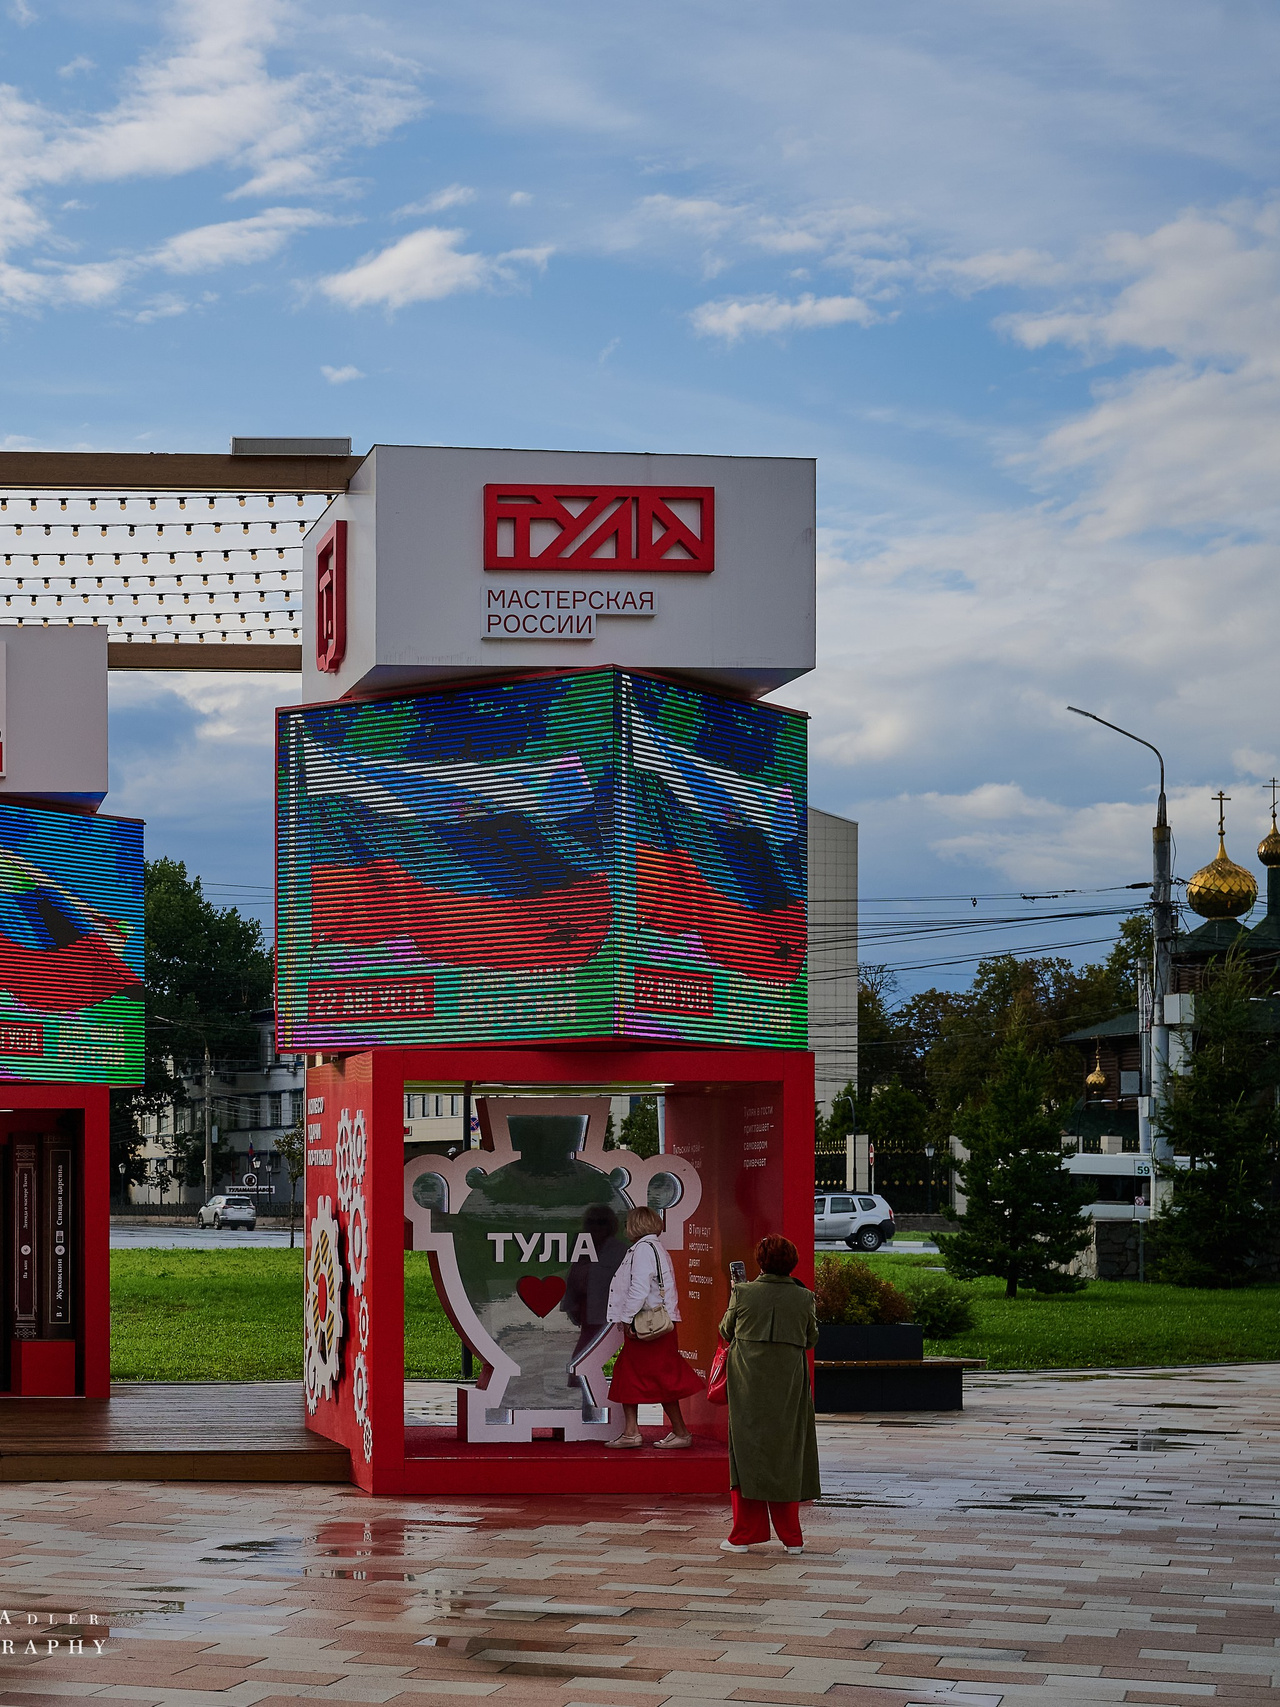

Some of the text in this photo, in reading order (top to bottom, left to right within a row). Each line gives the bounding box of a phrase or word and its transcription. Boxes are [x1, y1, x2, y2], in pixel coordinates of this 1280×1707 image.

[486, 589, 655, 610] МАСТЕРСКАЯ
[486, 613, 594, 634] РОССИИ
[1137, 1165, 1150, 1175] 59
[56, 1164, 65, 1226] Спящая царевна
[486, 1232, 600, 1263] ТУЛА
